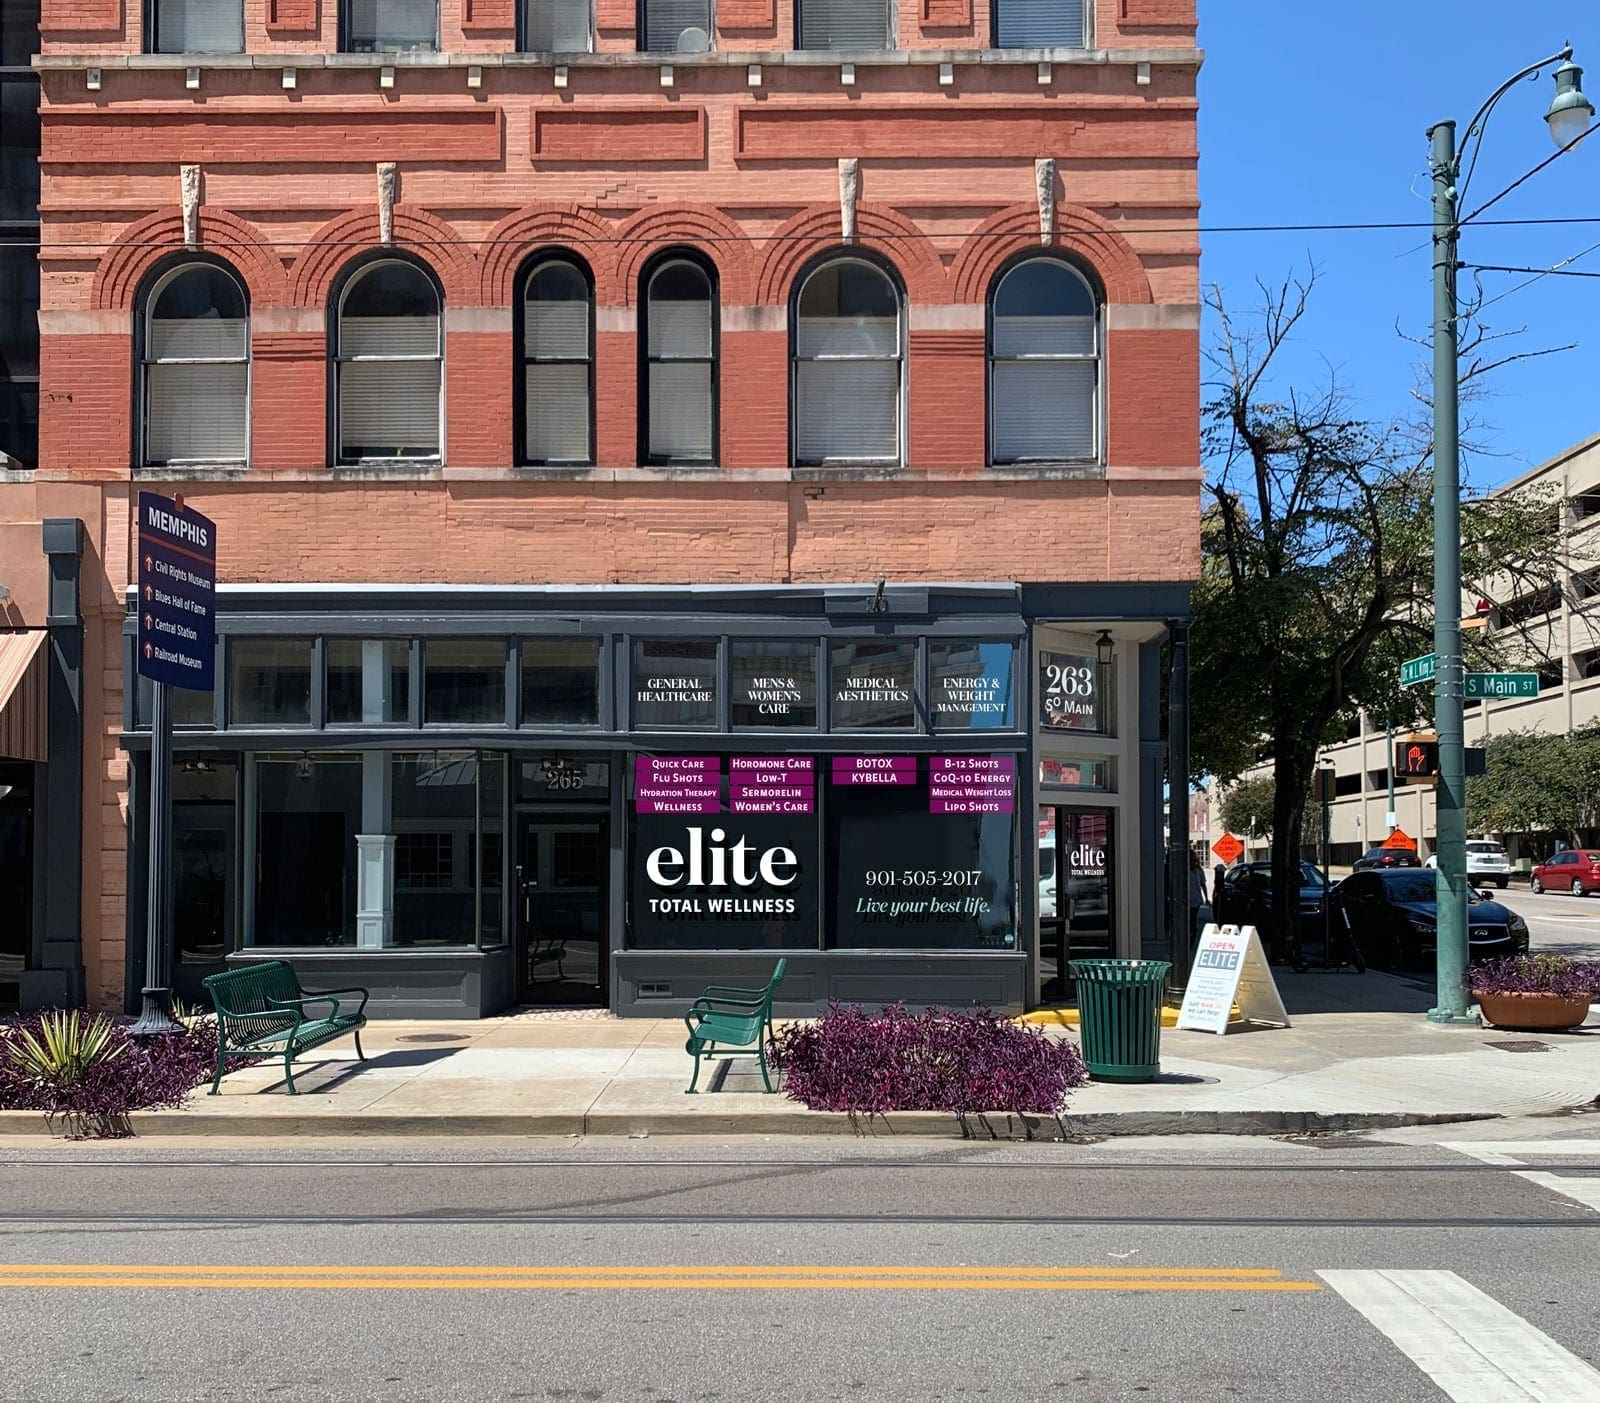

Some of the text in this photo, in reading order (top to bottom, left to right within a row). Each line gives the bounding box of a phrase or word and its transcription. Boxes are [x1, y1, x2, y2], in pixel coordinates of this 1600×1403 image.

[149, 506, 208, 547] MEMPHIS
[155, 560, 211, 590] Civil Rights Museum
[155, 590, 206, 616] Blues Hall of Fame
[154, 618, 197, 641] Central Station
[154, 647, 202, 669] Railroad Museum
[648, 678, 702, 689] GENERAL
[753, 678, 795, 689] MENS &
[846, 678, 899, 689] MEDICAL
[943, 678, 1000, 689] ENERGY &
[1046, 664, 1093, 697] 263
[1469, 678, 1533, 694] S Main ST
[637, 691, 713, 702] HEALTHCARE
[747, 690, 801, 701] WOMEN'S
[836, 690, 909, 701] AESTHETICS
[947, 690, 996, 701] WEIGHT
[758, 703, 790, 714] CARE
[937, 703, 1006, 712] MANAGEMENT
[856, 759, 893, 769] BOTOX
[945, 759, 966, 769] B-12
[547, 770, 584, 790] 265
[852, 773, 897, 783] KYBELLA
[646, 826, 798, 887] elite
[1070, 844, 1105, 867] elite
[865, 870, 982, 886] 901-505-2017
[649, 898, 795, 913] TOTAL WELLNESS
[856, 897, 991, 917] Live your best life.
[1209, 941, 1236, 950] OPEN
[1199, 951, 1238, 968] ELITE
